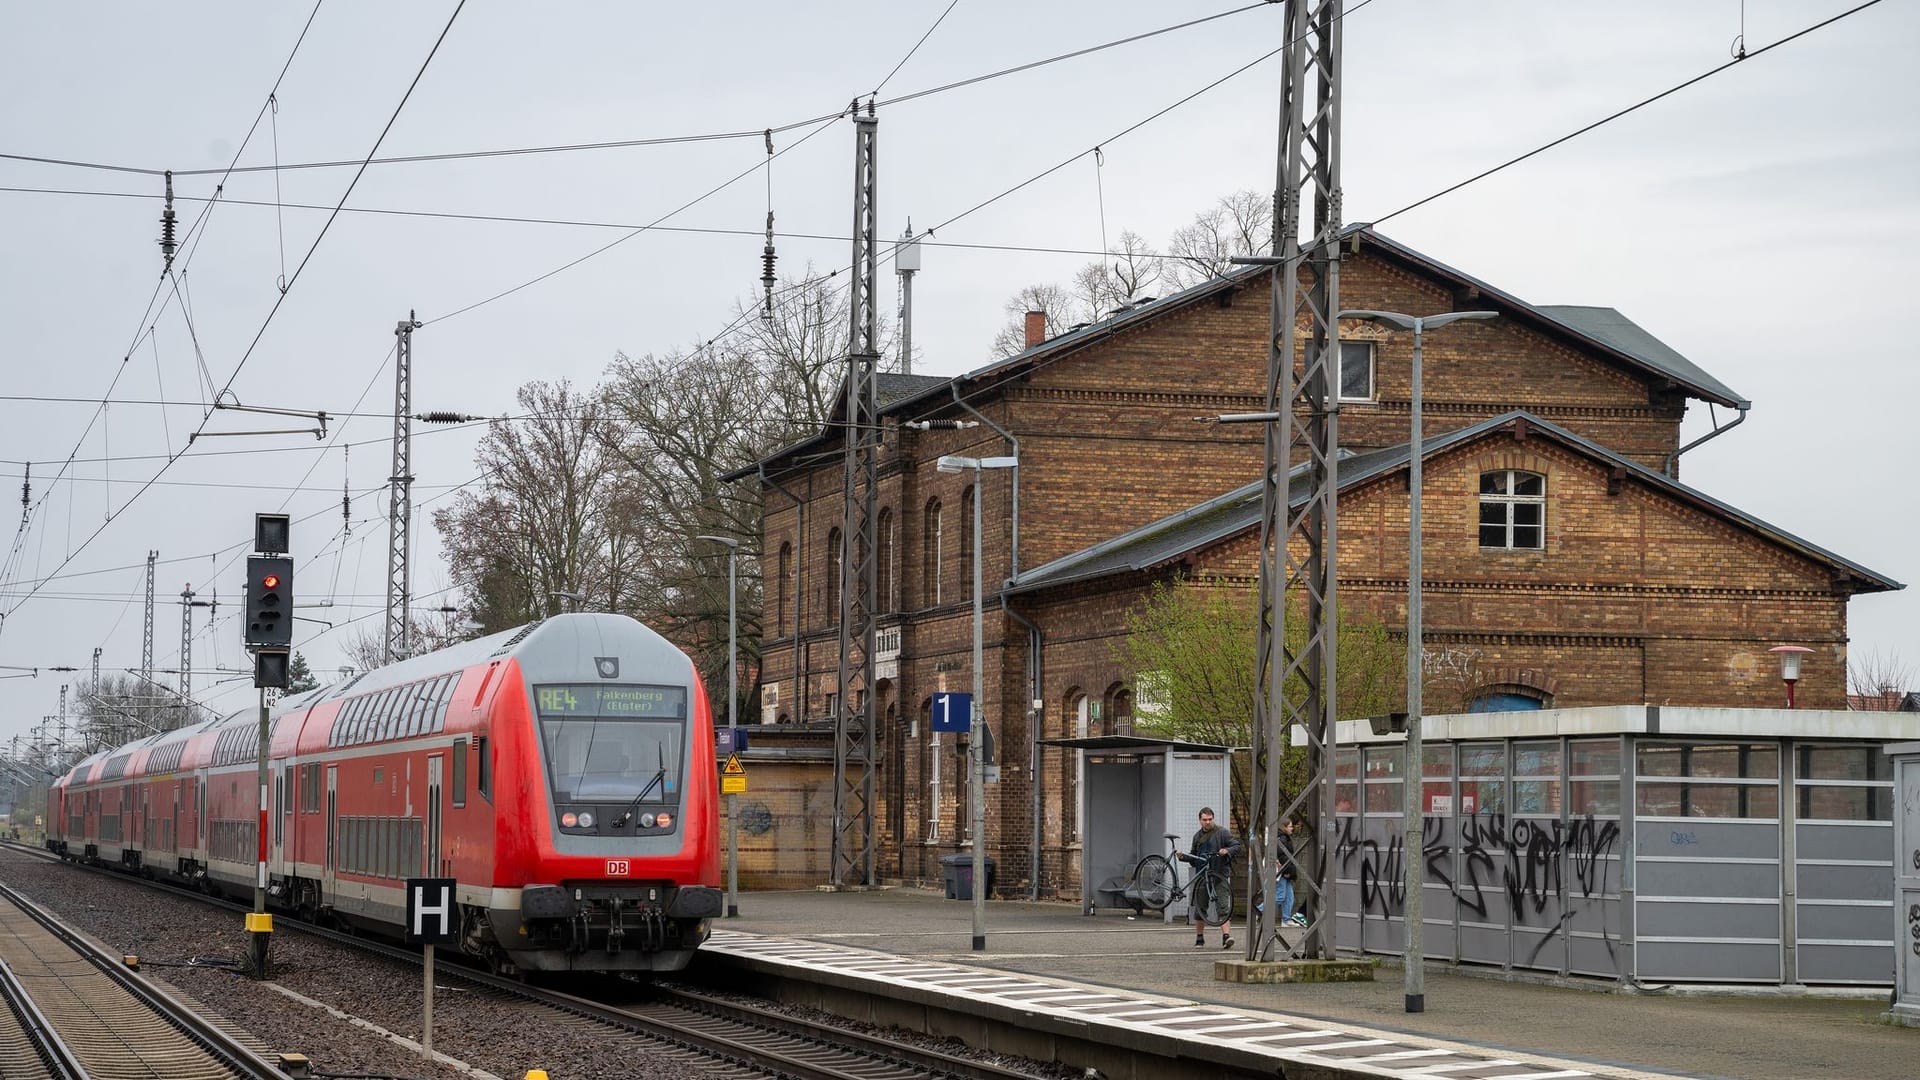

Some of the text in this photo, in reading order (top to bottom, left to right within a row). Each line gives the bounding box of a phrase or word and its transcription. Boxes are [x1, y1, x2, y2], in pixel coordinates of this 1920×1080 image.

[266, 688, 276, 697] 26
[595, 690, 663, 702] Falkenberg
[266, 698, 276, 707] N2
[539, 689, 578, 711] RE4
[607, 701, 653, 712] (Elster)
[937, 694, 950, 724] 1
[608, 861, 628, 875] DB
[413, 886, 449, 935] H
